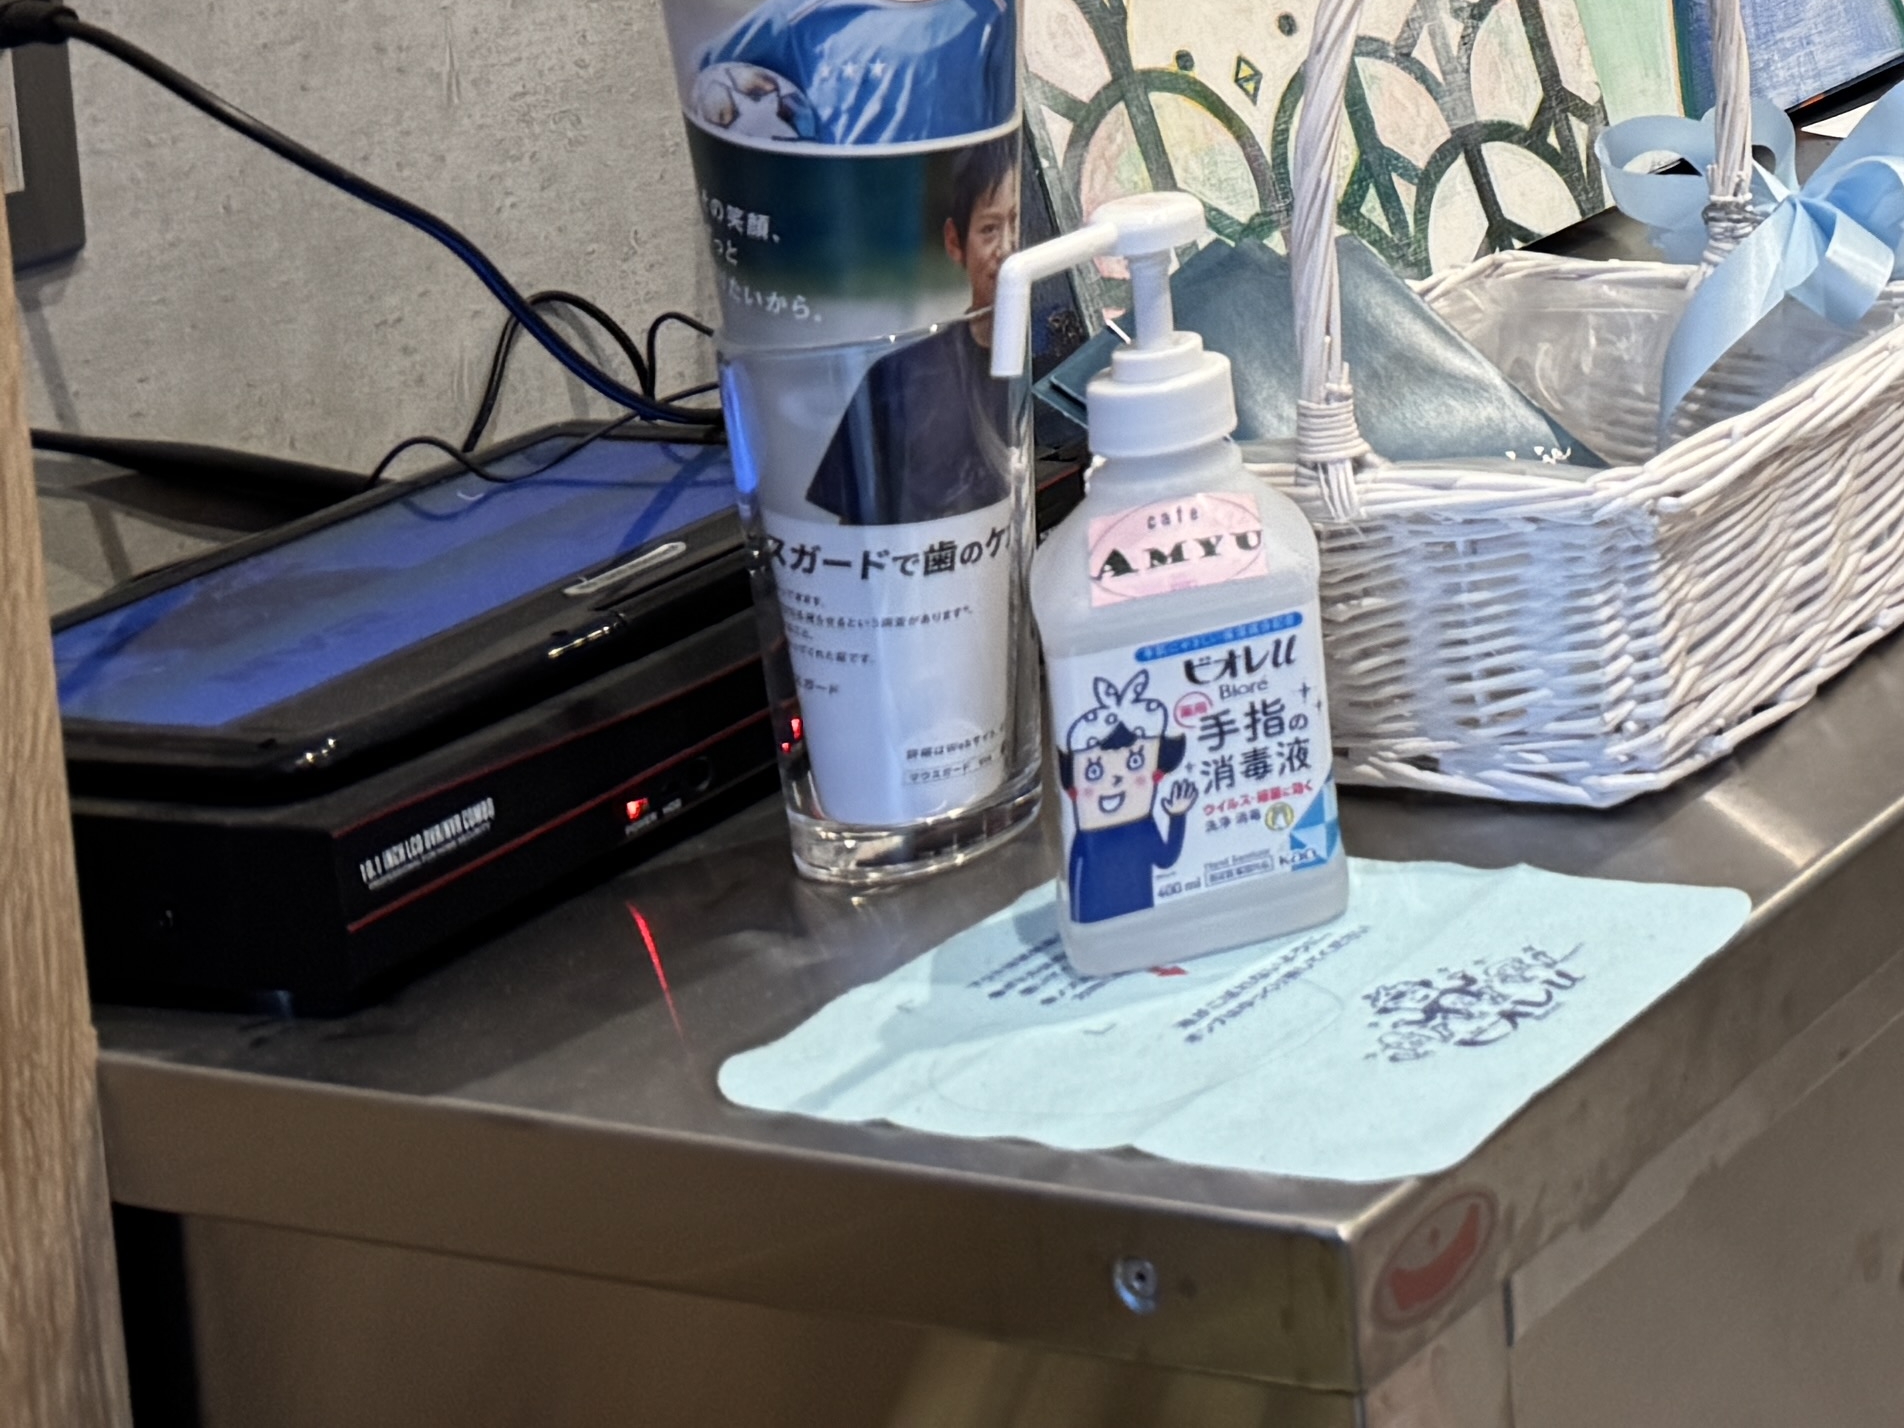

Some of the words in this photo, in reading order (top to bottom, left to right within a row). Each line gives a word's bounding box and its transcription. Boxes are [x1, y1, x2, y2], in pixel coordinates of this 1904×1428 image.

[702, 190, 781, 244] の笑顔、
[721, 275, 823, 323] たいから。
[1147, 506, 1199, 532] cafe
[1091, 529, 1262, 582] AMYU
[1197, 698, 1309, 753] 手指の
[1201, 737, 1313, 795] 消毒液
